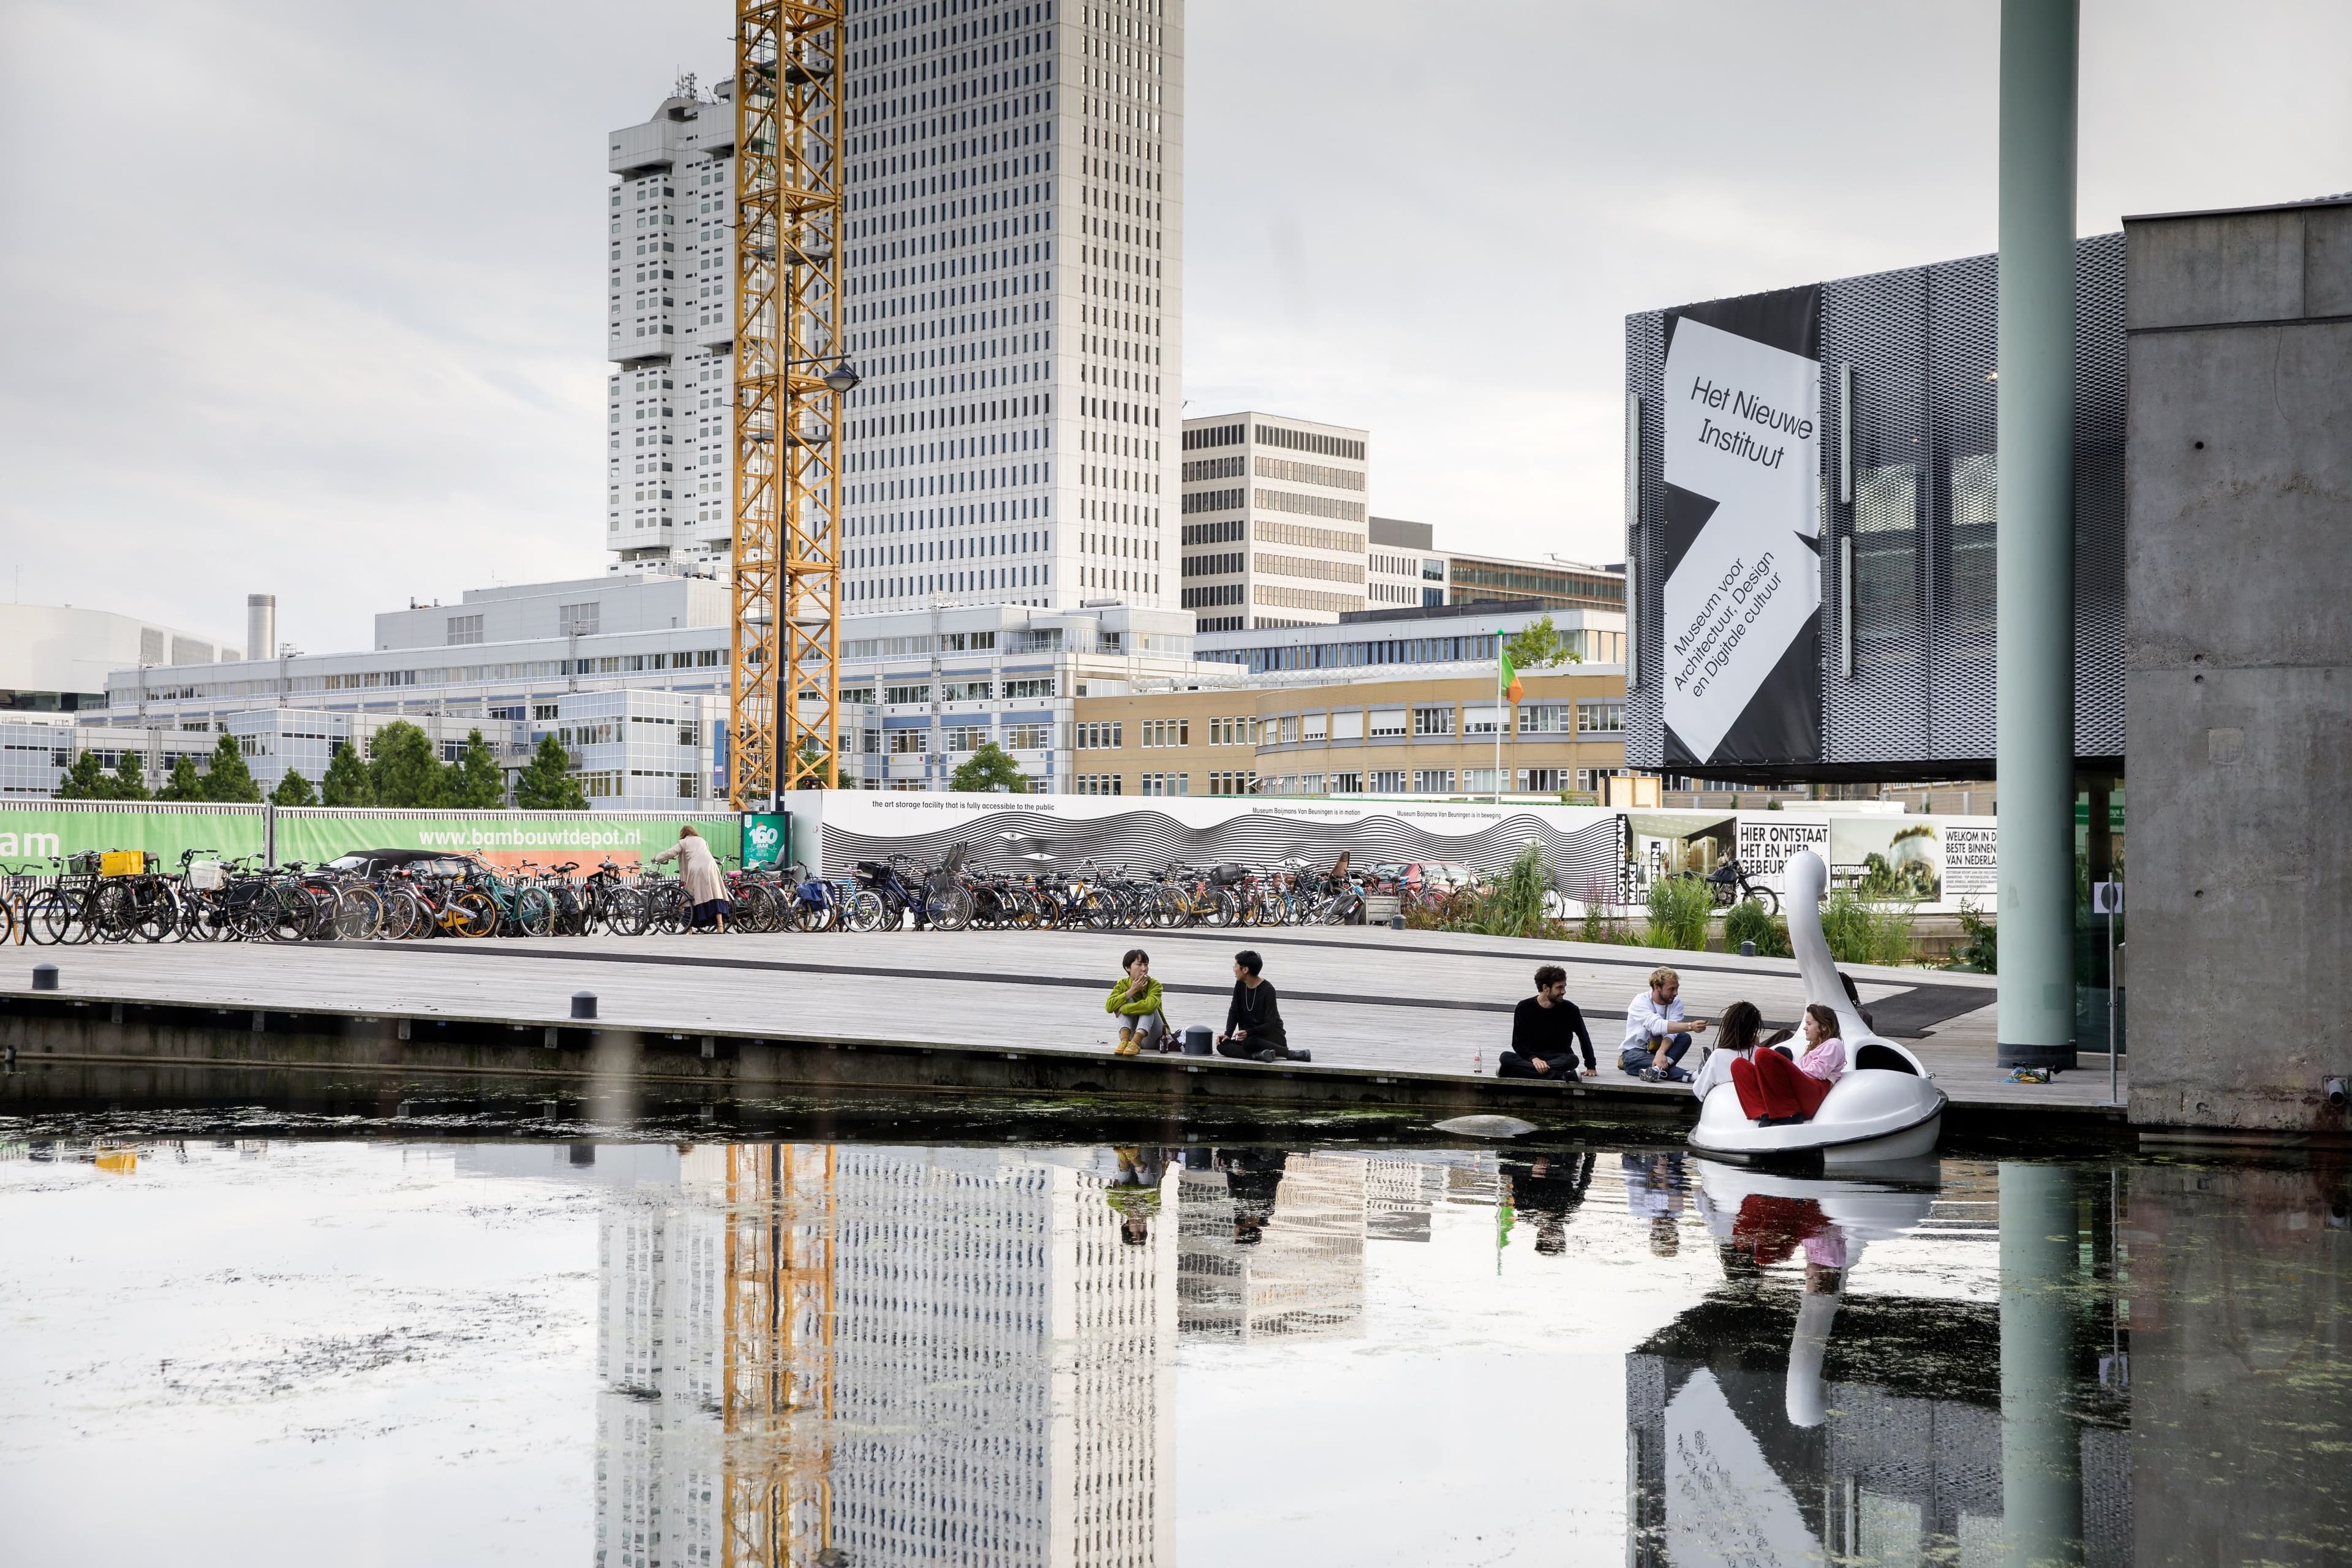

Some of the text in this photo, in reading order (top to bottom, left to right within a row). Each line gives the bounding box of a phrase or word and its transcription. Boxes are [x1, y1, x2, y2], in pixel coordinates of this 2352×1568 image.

[1691, 376, 1814, 440] Het Nieuwe
[1698, 418, 1785, 470] Instituut
[1674, 558, 1744, 657] Museum voor
[1675, 552, 1774, 692] Architectuur, Design
[1693, 572, 1782, 698] en Digitale cultuur
[895, 801, 921, 809] storage
[922, 801, 943, 810] facility
[967, 802, 980, 810] fully
[419, 828, 641, 849] www.bambouwtdepot.nl
[748, 825, 778, 844] 160
[1741, 827, 1766, 842] HIER
[1770, 827, 1828, 842] ONTSTAAT
[1945, 831, 1979, 841] WELKOM
[1981, 832, 1989, 841] IN
[1741, 843, 1760, 858] HET
[1765, 844, 1779, 858] EN
[1946, 843, 1997, 853] BESTE BINNEN
[1742, 860, 1788, 874] GEBEUR
[1946, 855, 1962, 865] VAN
[1832, 865, 1872, 875] ROTTERDAM.
[1852, 879, 1859, 889] IT
